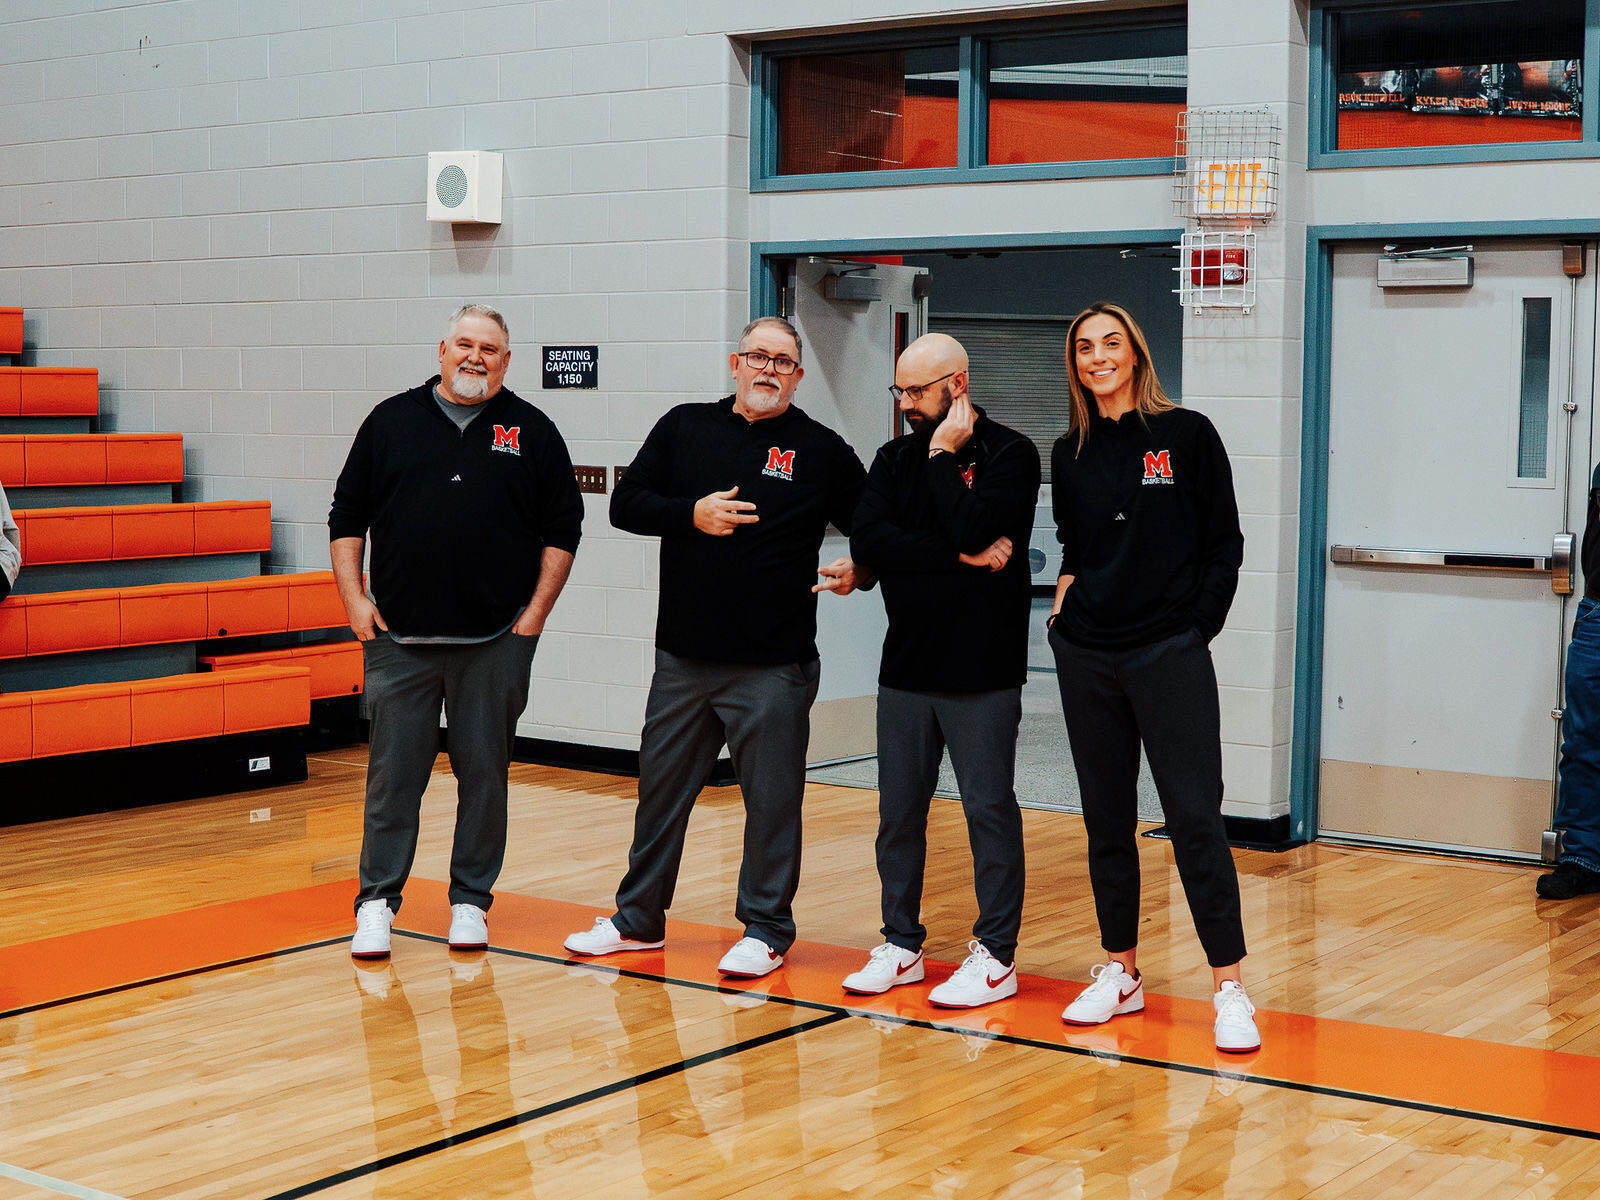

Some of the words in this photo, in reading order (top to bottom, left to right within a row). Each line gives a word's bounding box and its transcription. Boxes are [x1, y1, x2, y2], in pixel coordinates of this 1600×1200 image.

[1416, 96, 1449, 106] KYLER
[1506, 101, 1538, 110] JUSTIN
[1208, 163, 1261, 209] EXIT
[549, 350, 591, 361] SEATING
[545, 361, 594, 372] CAPACITY
[557, 373, 582, 385] 1,150
[493, 424, 520, 450] M
[491, 445, 521, 456] BASKETBALL
[765, 446, 796, 475] M
[1143, 449, 1173, 478] M
[761, 468, 793, 481] BASKETBALL
[1141, 477, 1175, 485] BASKETBALL
